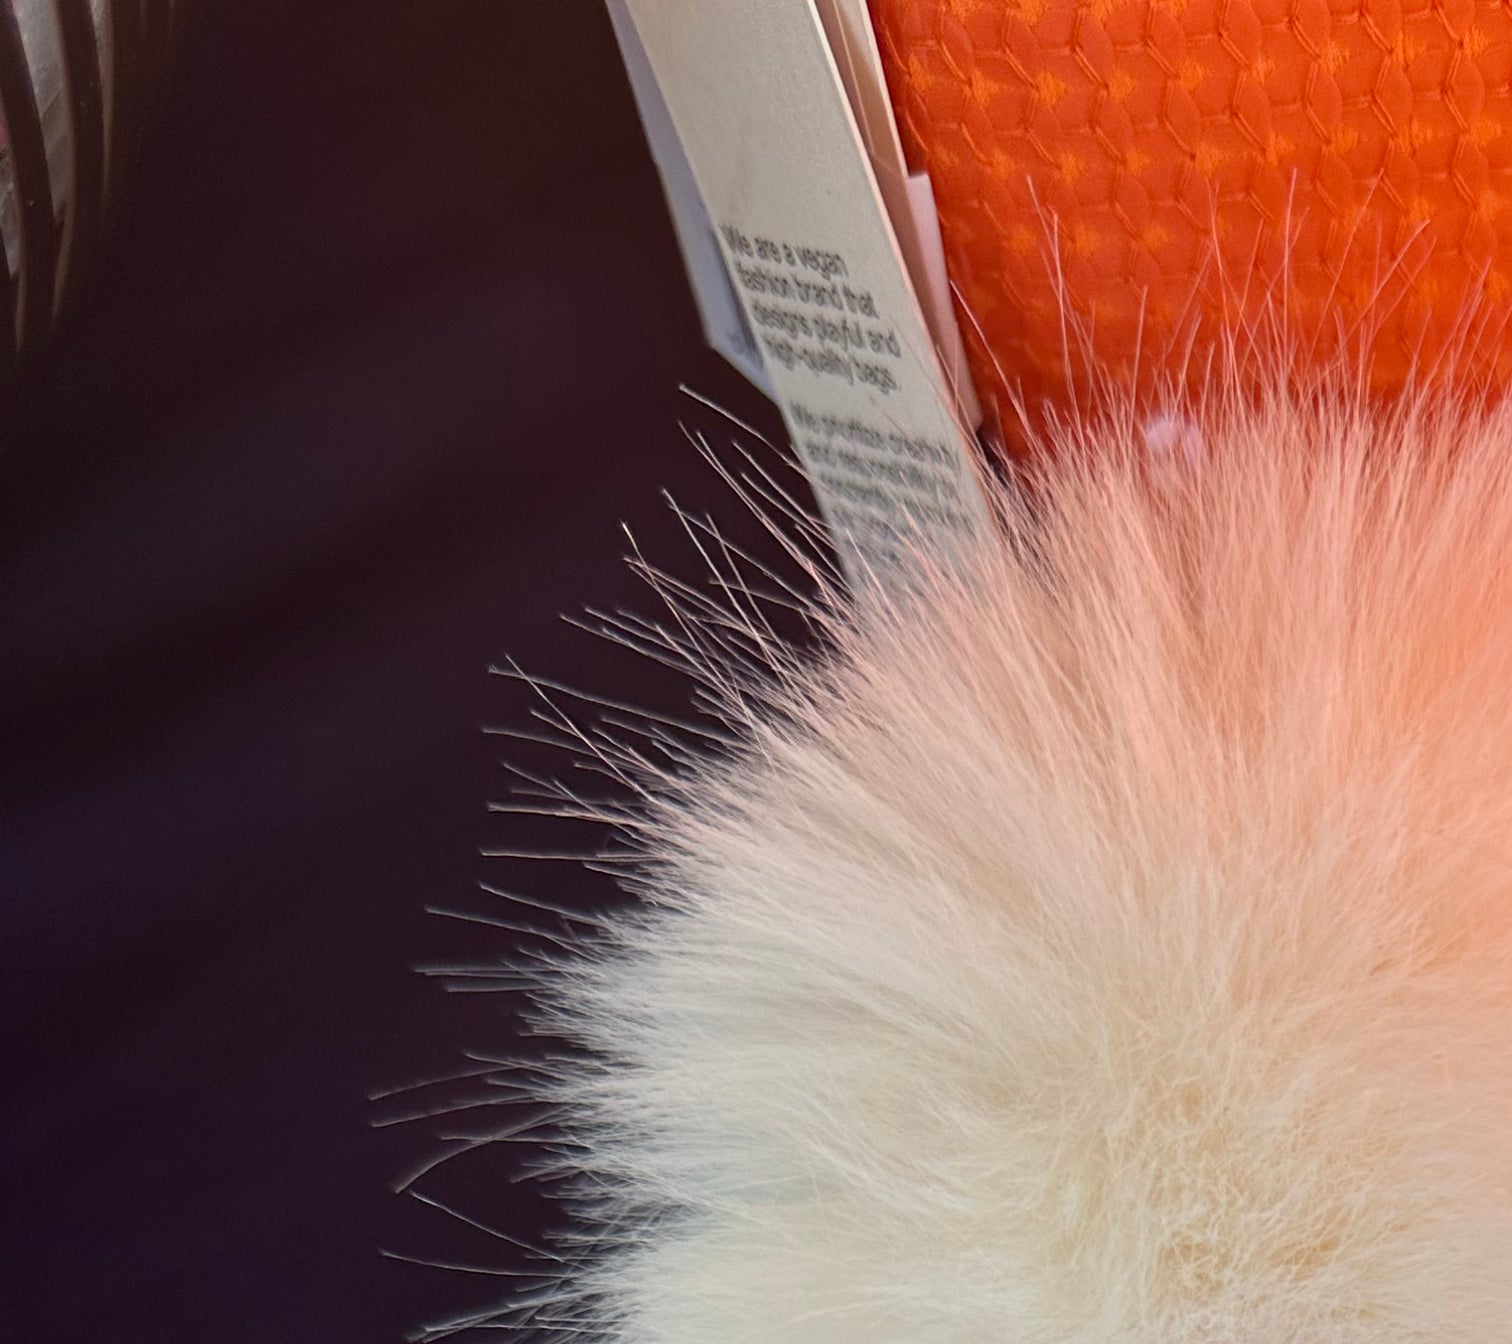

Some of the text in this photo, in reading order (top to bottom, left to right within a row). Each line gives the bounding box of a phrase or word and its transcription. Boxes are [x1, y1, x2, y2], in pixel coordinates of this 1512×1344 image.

[719, 224, 849, 280] We are a vegan
[791, 272, 844, 310] brand
[842, 282, 880, 319] that
[813, 313, 865, 352] playful
[867, 327, 901, 357] and
